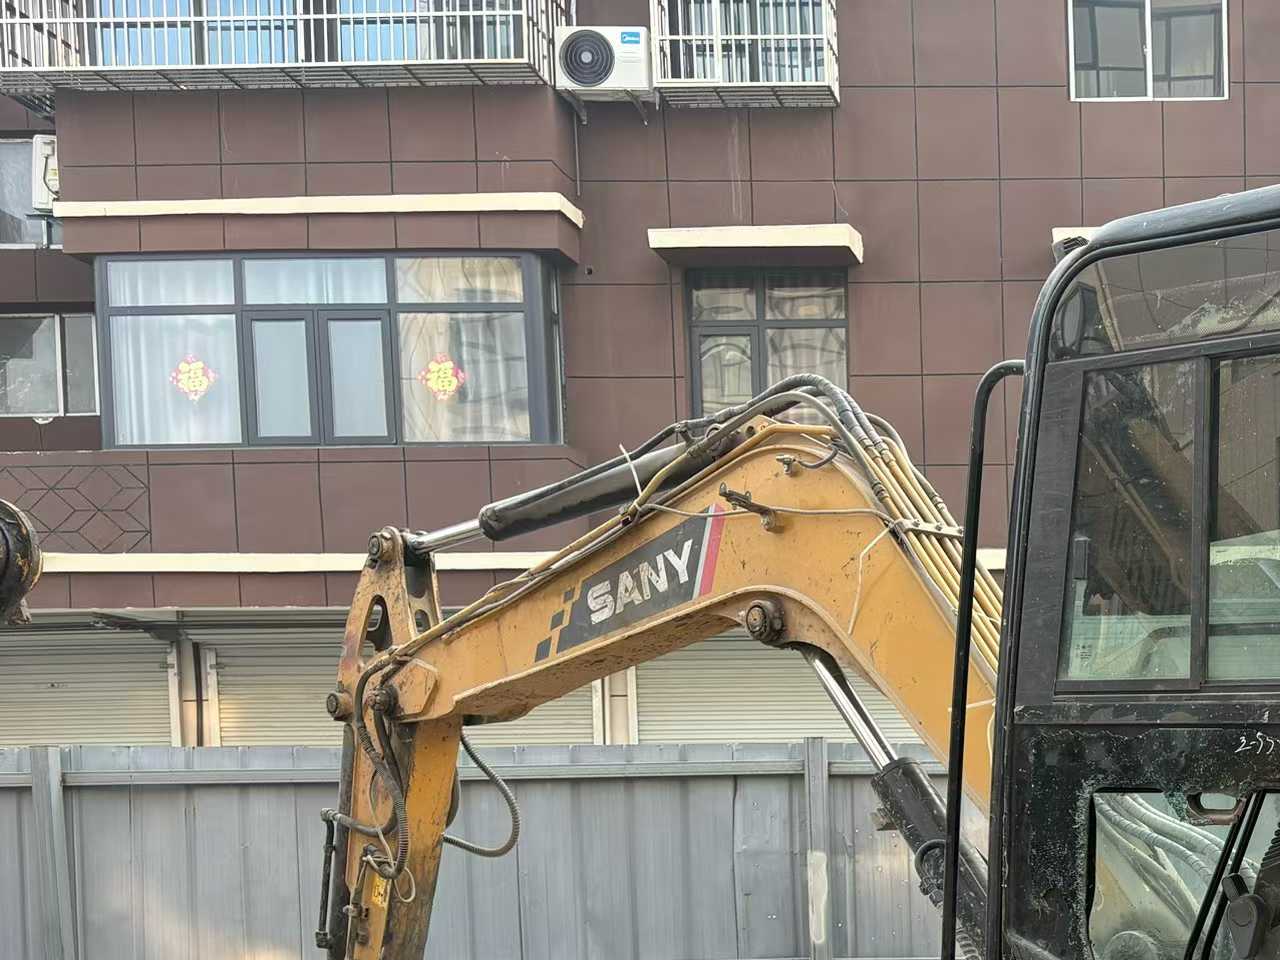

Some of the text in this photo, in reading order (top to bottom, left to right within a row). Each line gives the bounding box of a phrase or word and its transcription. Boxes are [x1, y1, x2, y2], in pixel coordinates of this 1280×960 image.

[177, 360, 208, 392] 福
[426, 360, 458, 392] 福
[587, 539, 693, 625] SANY
